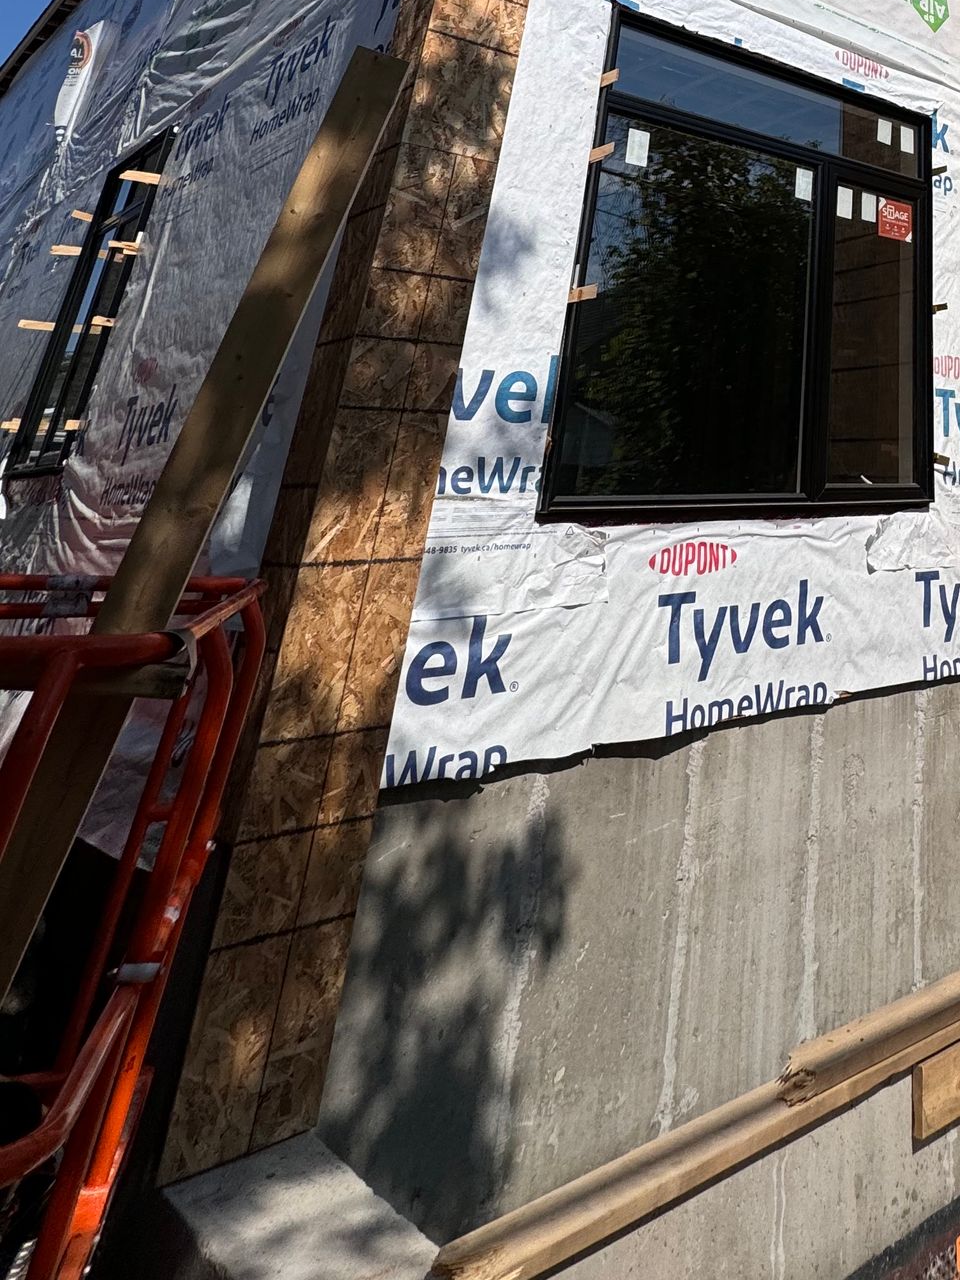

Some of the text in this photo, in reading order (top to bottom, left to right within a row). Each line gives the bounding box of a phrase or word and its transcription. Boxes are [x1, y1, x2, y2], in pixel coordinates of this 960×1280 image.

[263, 14, 337, 108] Tyvek
[841, 48, 885, 80] DUPONT
[249, 86, 320, 146] HomeWrap
[117, 383, 179, 467] Tyvek
[438, 456, 543, 495] eWr
[424, 545, 458, 555] 48-9835
[660, 541, 729, 576] DUPONT
[658, 578, 825, 683] Tyvek
[665, 679, 828, 737] HomeWrap
